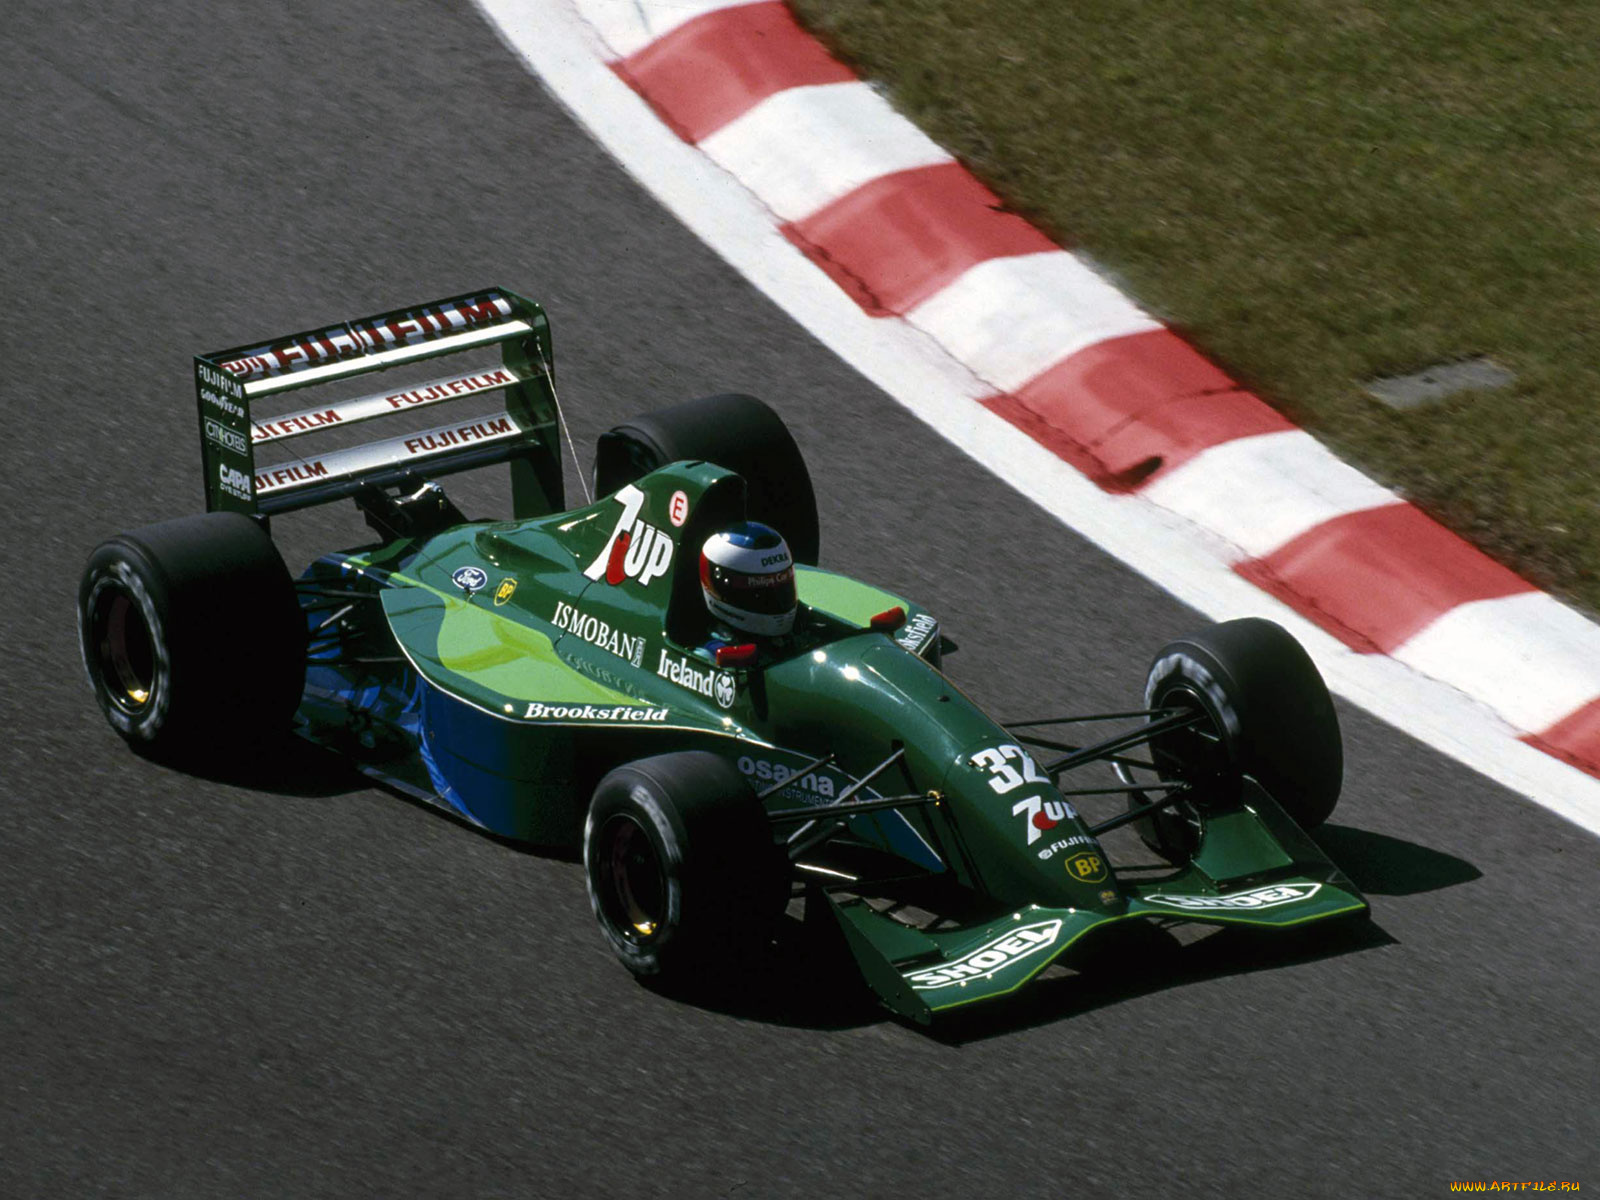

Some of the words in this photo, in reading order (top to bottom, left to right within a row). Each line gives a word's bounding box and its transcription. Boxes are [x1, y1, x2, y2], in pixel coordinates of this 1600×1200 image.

[672, 497, 685, 521] E
[457, 569, 483, 587] Ford
[498, 583, 514, 598] BP
[551, 601, 637, 660] ISMOBAN
[657, 649, 715, 698] Ireland
[524, 702, 669, 721] Brooksfield
[971, 744, 1051, 795] 32
[1075, 857, 1101, 877] BP
